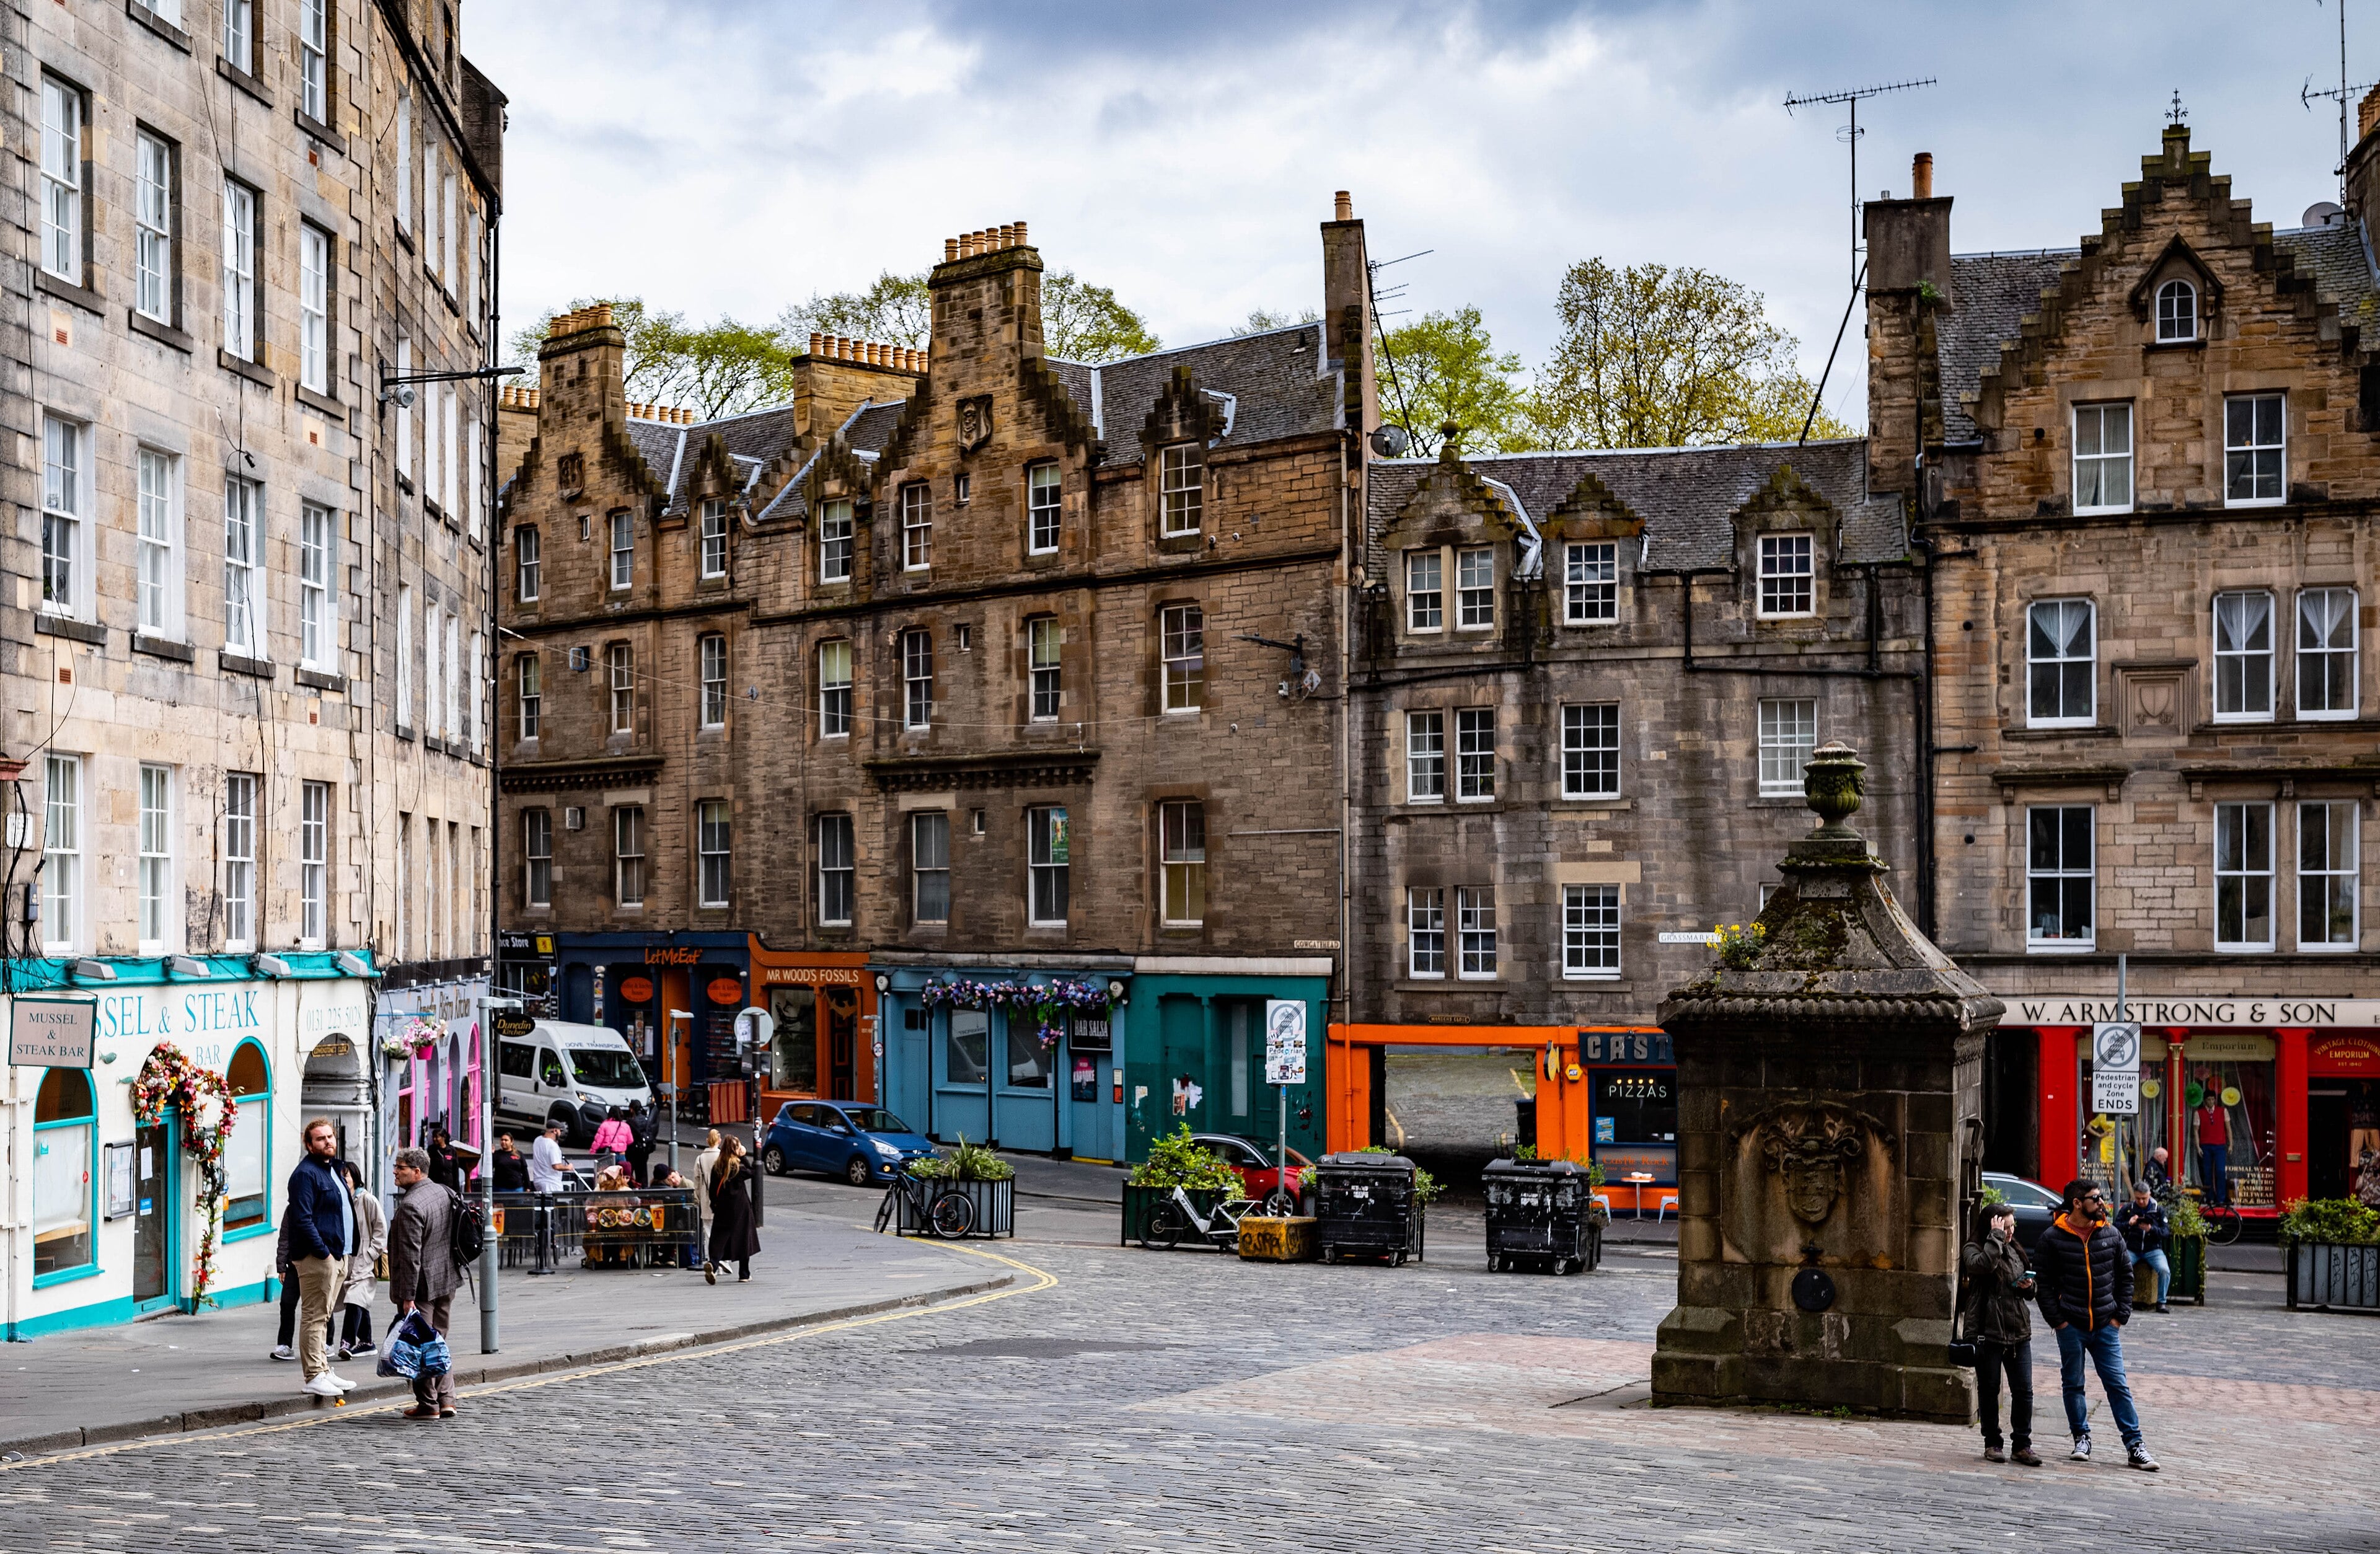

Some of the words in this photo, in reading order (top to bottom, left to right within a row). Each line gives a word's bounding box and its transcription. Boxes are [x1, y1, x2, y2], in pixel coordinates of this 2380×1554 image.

[510, 937, 529, 948] Store
[766, 969, 781, 981] MR
[783, 969, 817, 982] WOOD'S
[819, 969, 860, 983] FOSSILS
[159, 1006, 172, 1033] &
[185, 991, 260, 1033] STEAK
[306, 1009, 322, 1031] 0131
[328, 1008, 342, 1029] 225
[345, 1005, 362, 1028] 5028
[2022, 1002, 2050, 1022] W.
[2059, 1002, 2235, 1023] ARMSTRONG
[2250, 1003, 2267, 1023] &
[2280, 1003, 2335, 1023] SON
[29, 1012, 77, 1025] MUSSEL
[497, 1018, 532, 1030] Dunedin
[47, 1029, 56, 1040] &
[1074, 1020, 1088, 1036] BAR
[1089, 1020, 1109, 1037] SALSA
[16, 1044, 56, 1056] STEAK
[60, 1045, 86, 1057] BAR
[586, 1042, 624, 1050] TRANSPORT
[875, 1046, 883, 1054] 20
[2202, 1041, 2257, 1052] Emporium
[2314, 1038, 2346, 1056] VINTAGE
[195, 1044, 221, 1066] BAR
[2329, 1050, 2370, 1059] EMPORIUM
[2096, 1074, 2136, 1082] Pedestrian
[1609, 1085, 1667, 1098] PIZZAS
[2098, 1099, 2133, 1110] ENDS
[1602, 1154, 1636, 1165] Castle
[1641, 1155, 1669, 1165] Rock
[653, 1210, 663, 1220] T
